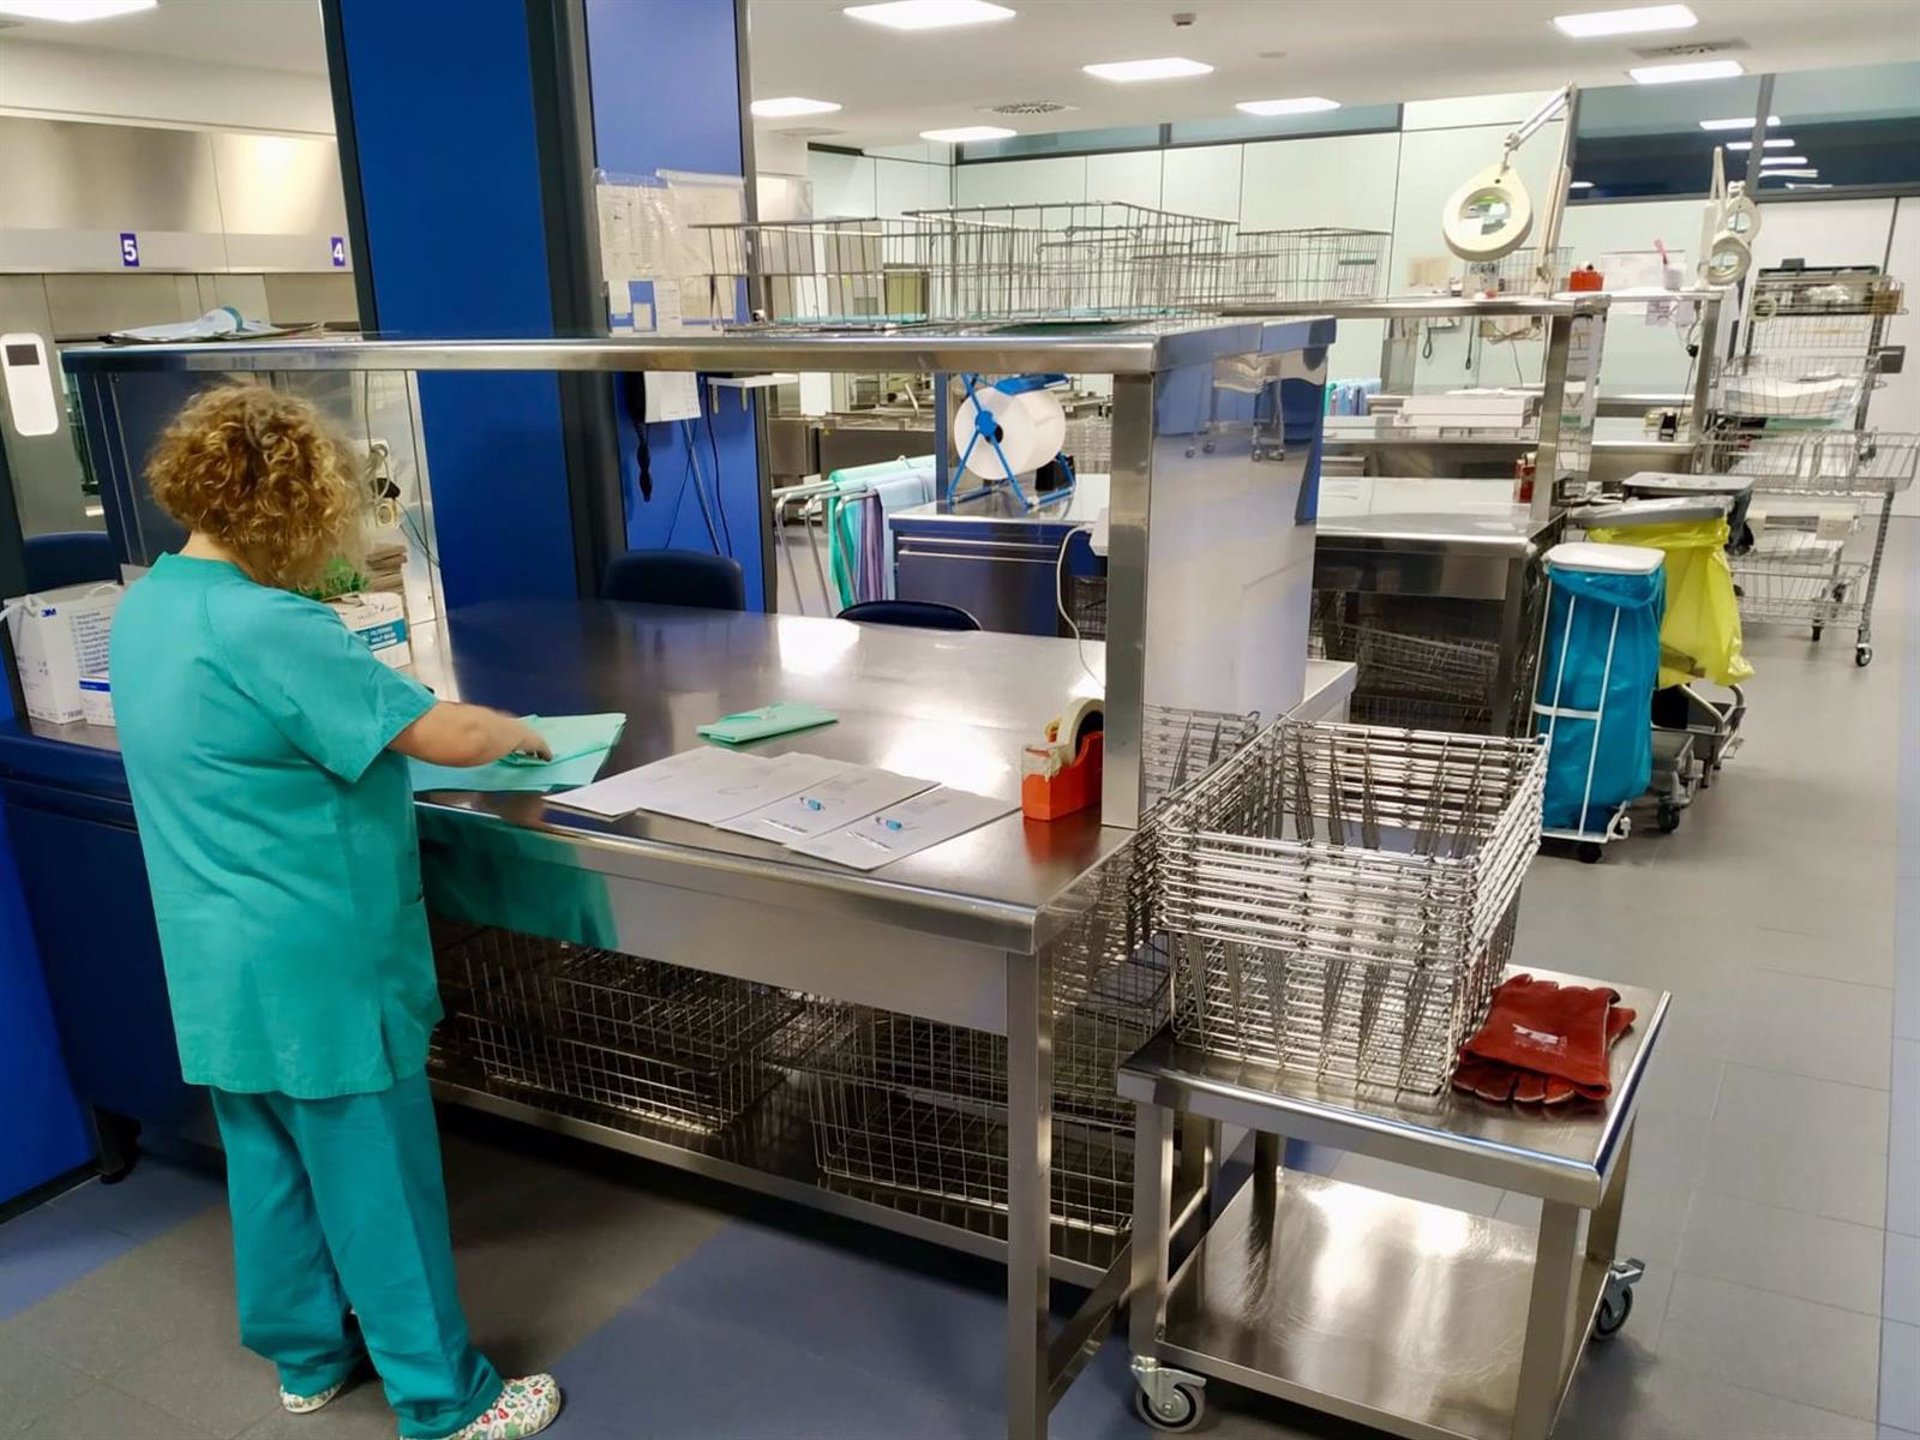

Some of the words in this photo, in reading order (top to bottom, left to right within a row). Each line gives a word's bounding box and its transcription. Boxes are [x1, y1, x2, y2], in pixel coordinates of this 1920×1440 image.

[123, 239, 137, 262] 5
[333, 242, 344, 262] 4
[41, 608, 57, 618] 3M
